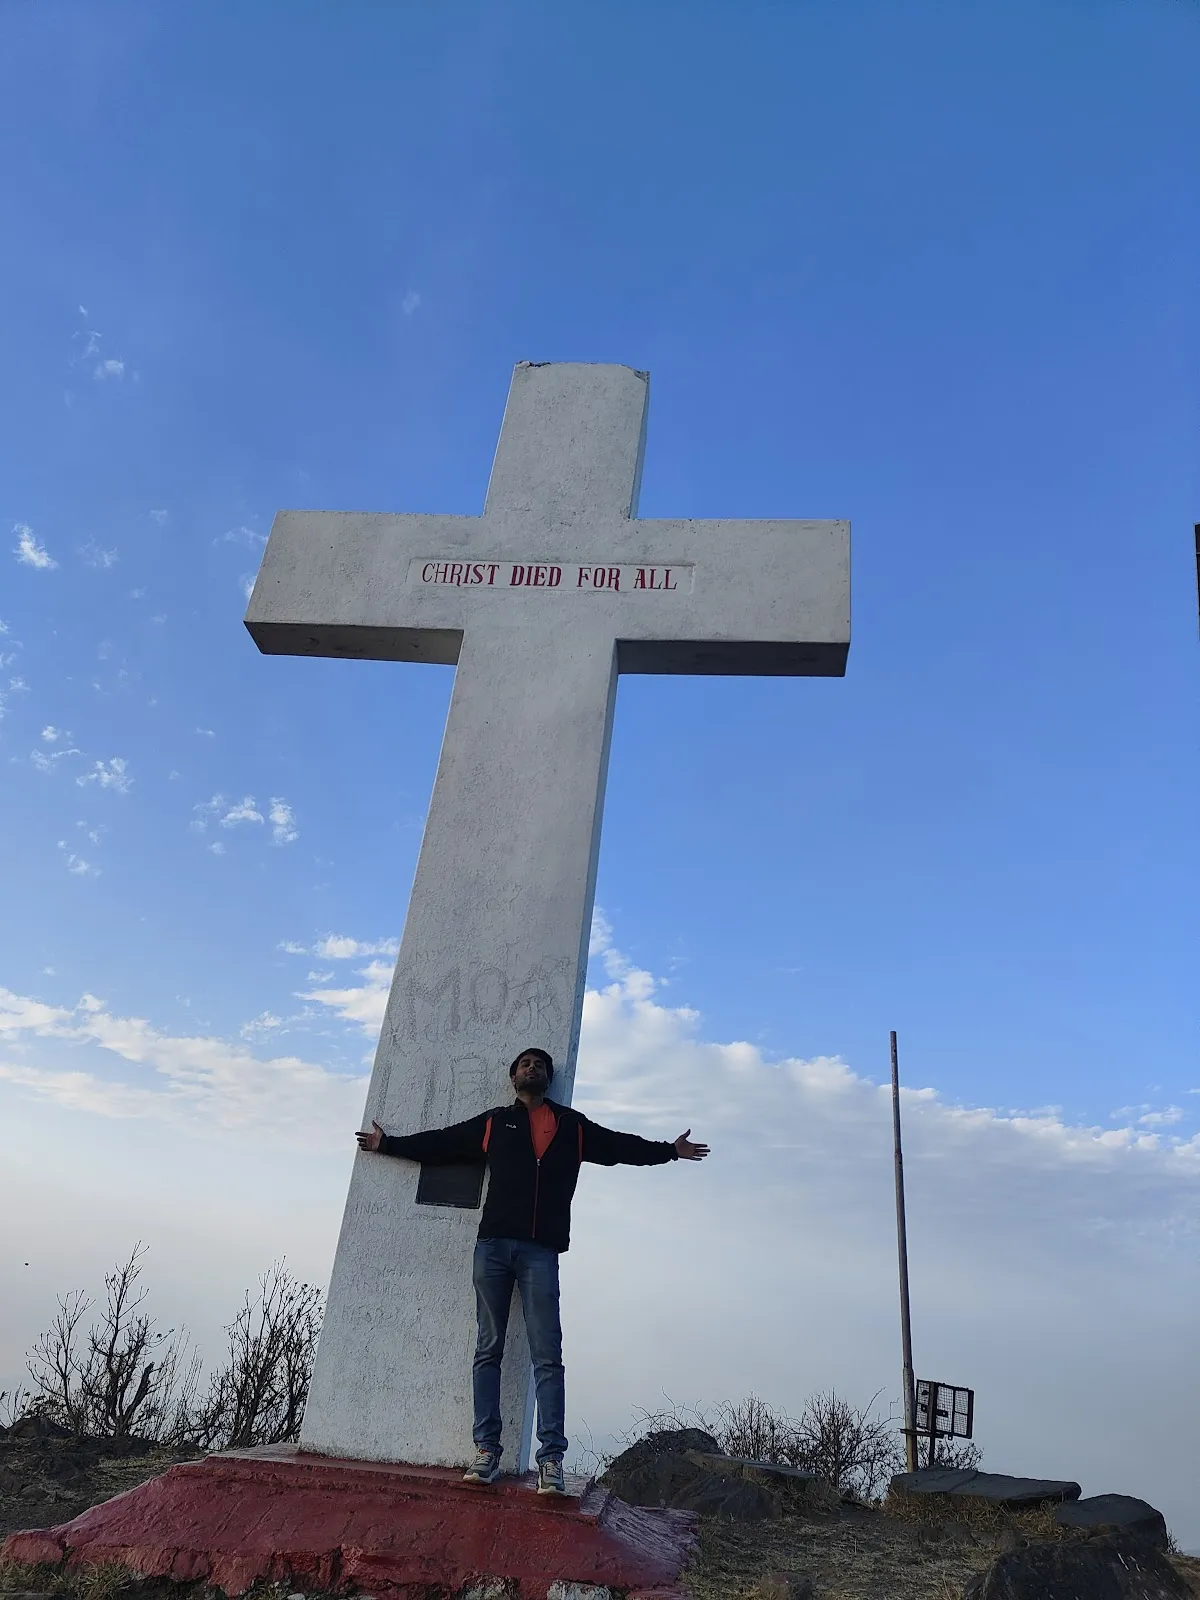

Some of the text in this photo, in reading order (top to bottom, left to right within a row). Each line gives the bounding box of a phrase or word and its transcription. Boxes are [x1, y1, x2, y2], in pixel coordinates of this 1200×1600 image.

[421, 562, 678, 592] CHRIST DIED FOR ALL
